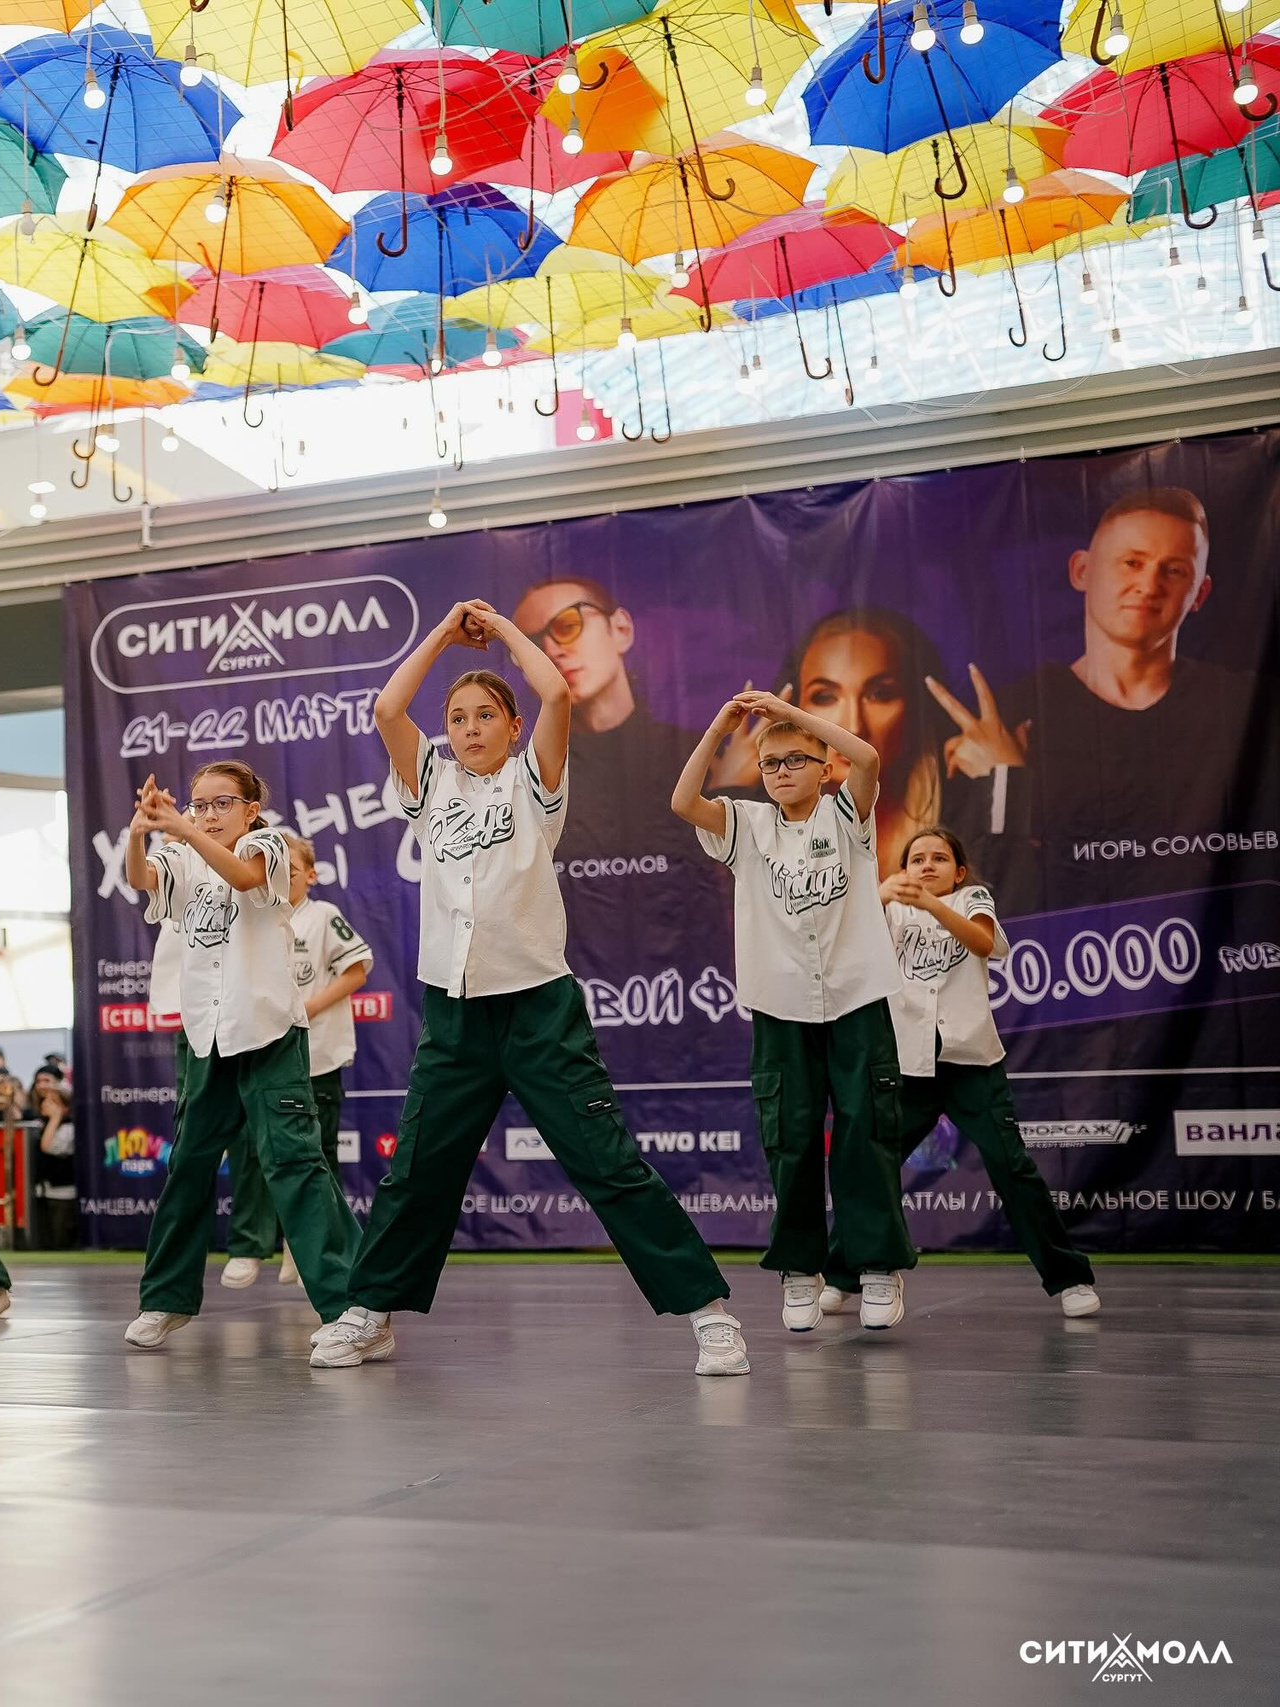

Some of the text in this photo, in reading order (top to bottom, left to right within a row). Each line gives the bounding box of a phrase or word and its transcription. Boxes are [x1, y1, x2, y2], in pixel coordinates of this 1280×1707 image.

[218, 654, 271, 672] СУРГУТ
[1073, 830, 1279, 861] ИГОРЬ СОЛОВЬЕВ
[568, 854, 669, 878] СОКОЛОВ
[330, 916, 355, 942] 8
[637, 1131, 741, 1152] TWO KEI
[1185, 1123, 1280, 1142] ванл
[1175, 1189, 1236, 1211] ШОУ
